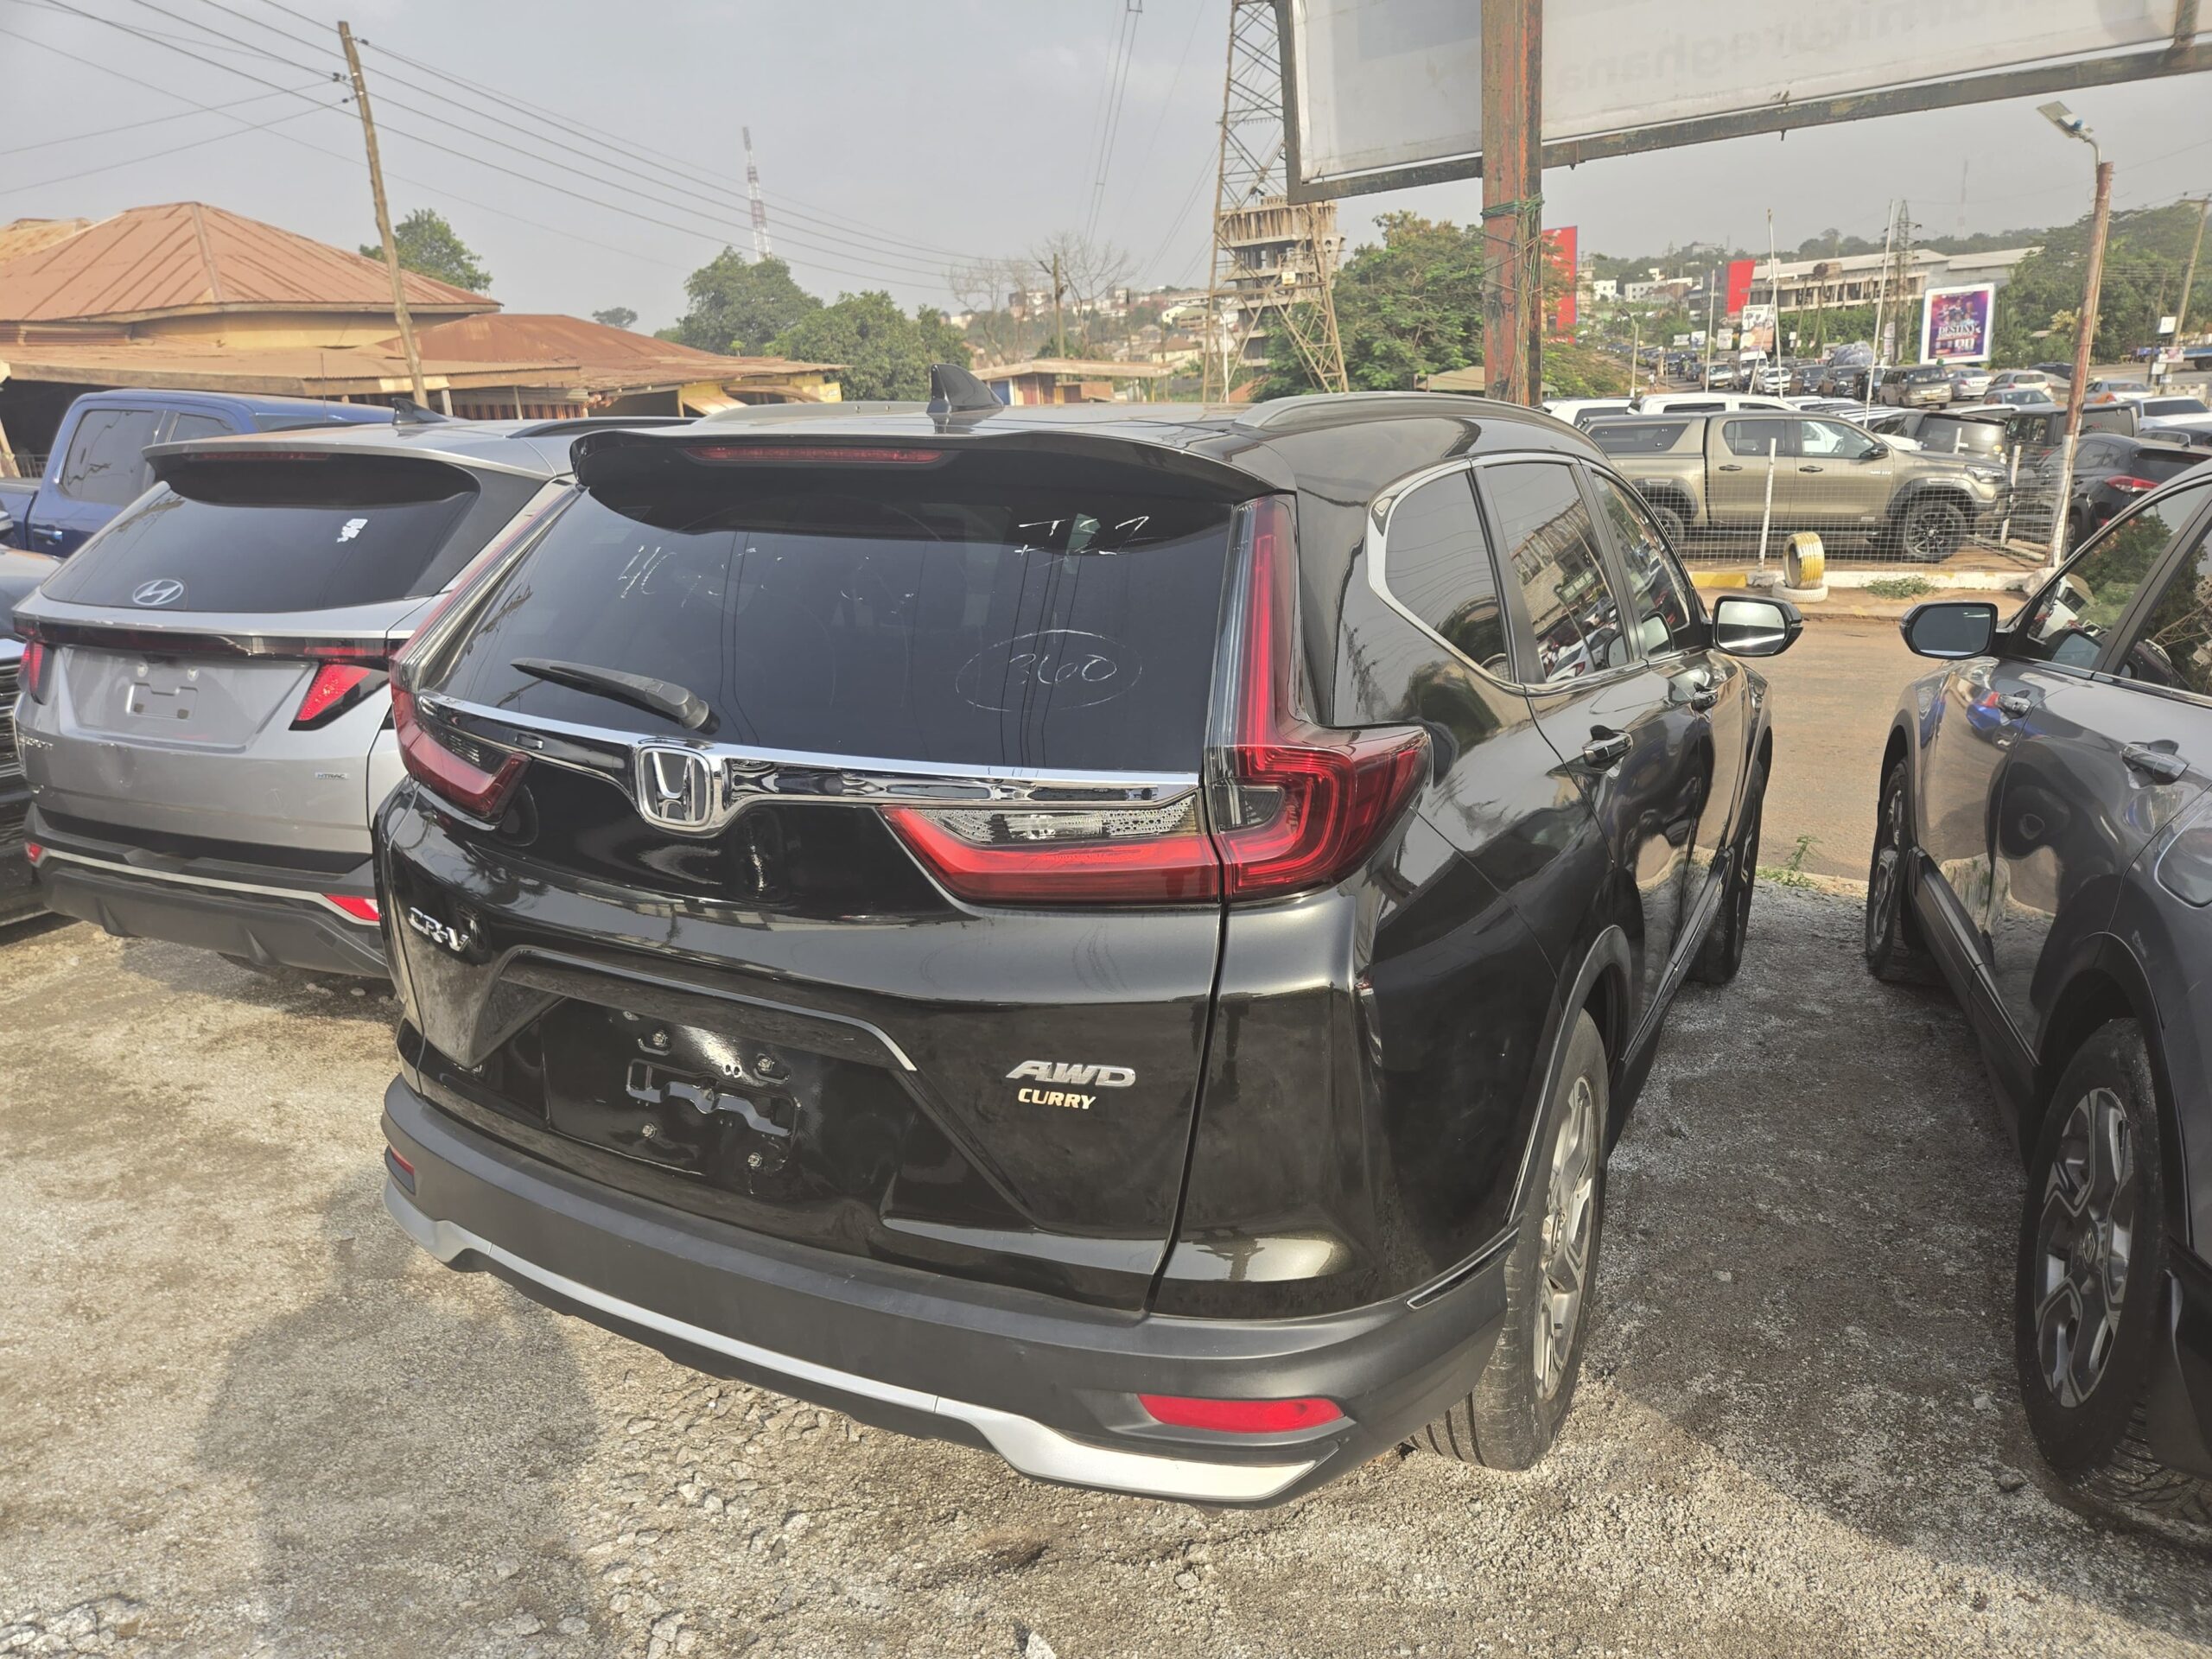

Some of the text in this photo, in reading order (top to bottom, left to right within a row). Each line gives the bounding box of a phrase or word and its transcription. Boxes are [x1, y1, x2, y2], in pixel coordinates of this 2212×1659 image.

[409, 906, 469, 951] CR-V
[1006, 1060, 1135, 1088] AWD
[1018, 1088, 1096, 1109] CURRY
